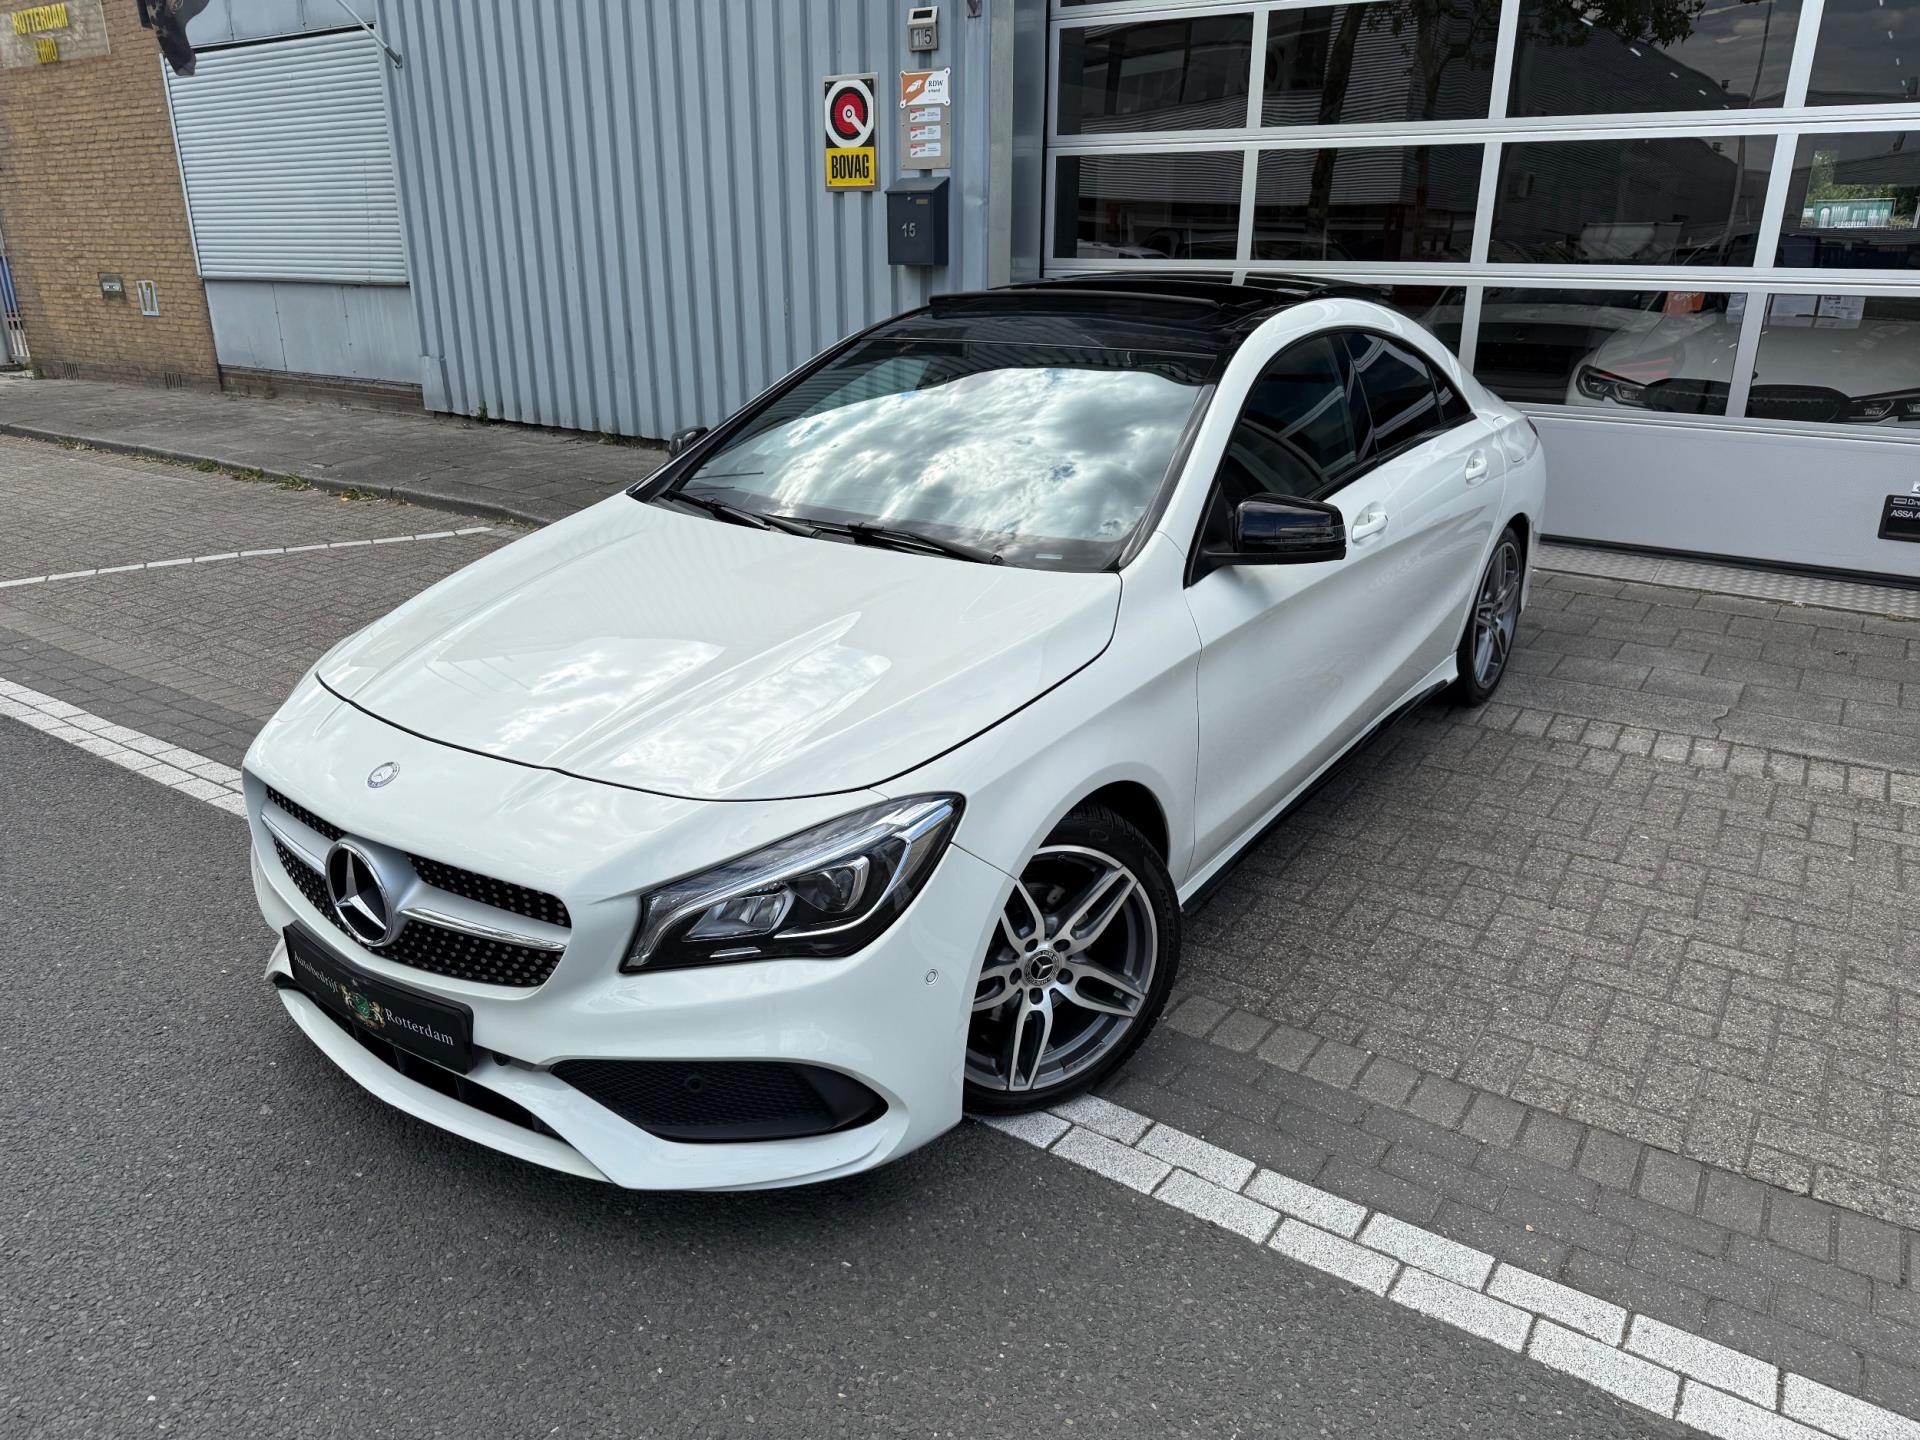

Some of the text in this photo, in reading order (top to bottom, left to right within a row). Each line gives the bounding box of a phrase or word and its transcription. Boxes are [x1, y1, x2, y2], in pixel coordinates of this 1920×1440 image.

[11, 2, 68, 36] ROTTERDAM
[915, 28, 932, 45] 15
[928, 79, 944, 87] RDW
[831, 154, 870, 179] BOVAG
[902, 222, 916, 238] 15
[138, 282, 154, 311] 17
[1890, 509, 1914, 519] ASSA
[384, 1007, 454, 1047] Rotterdam
